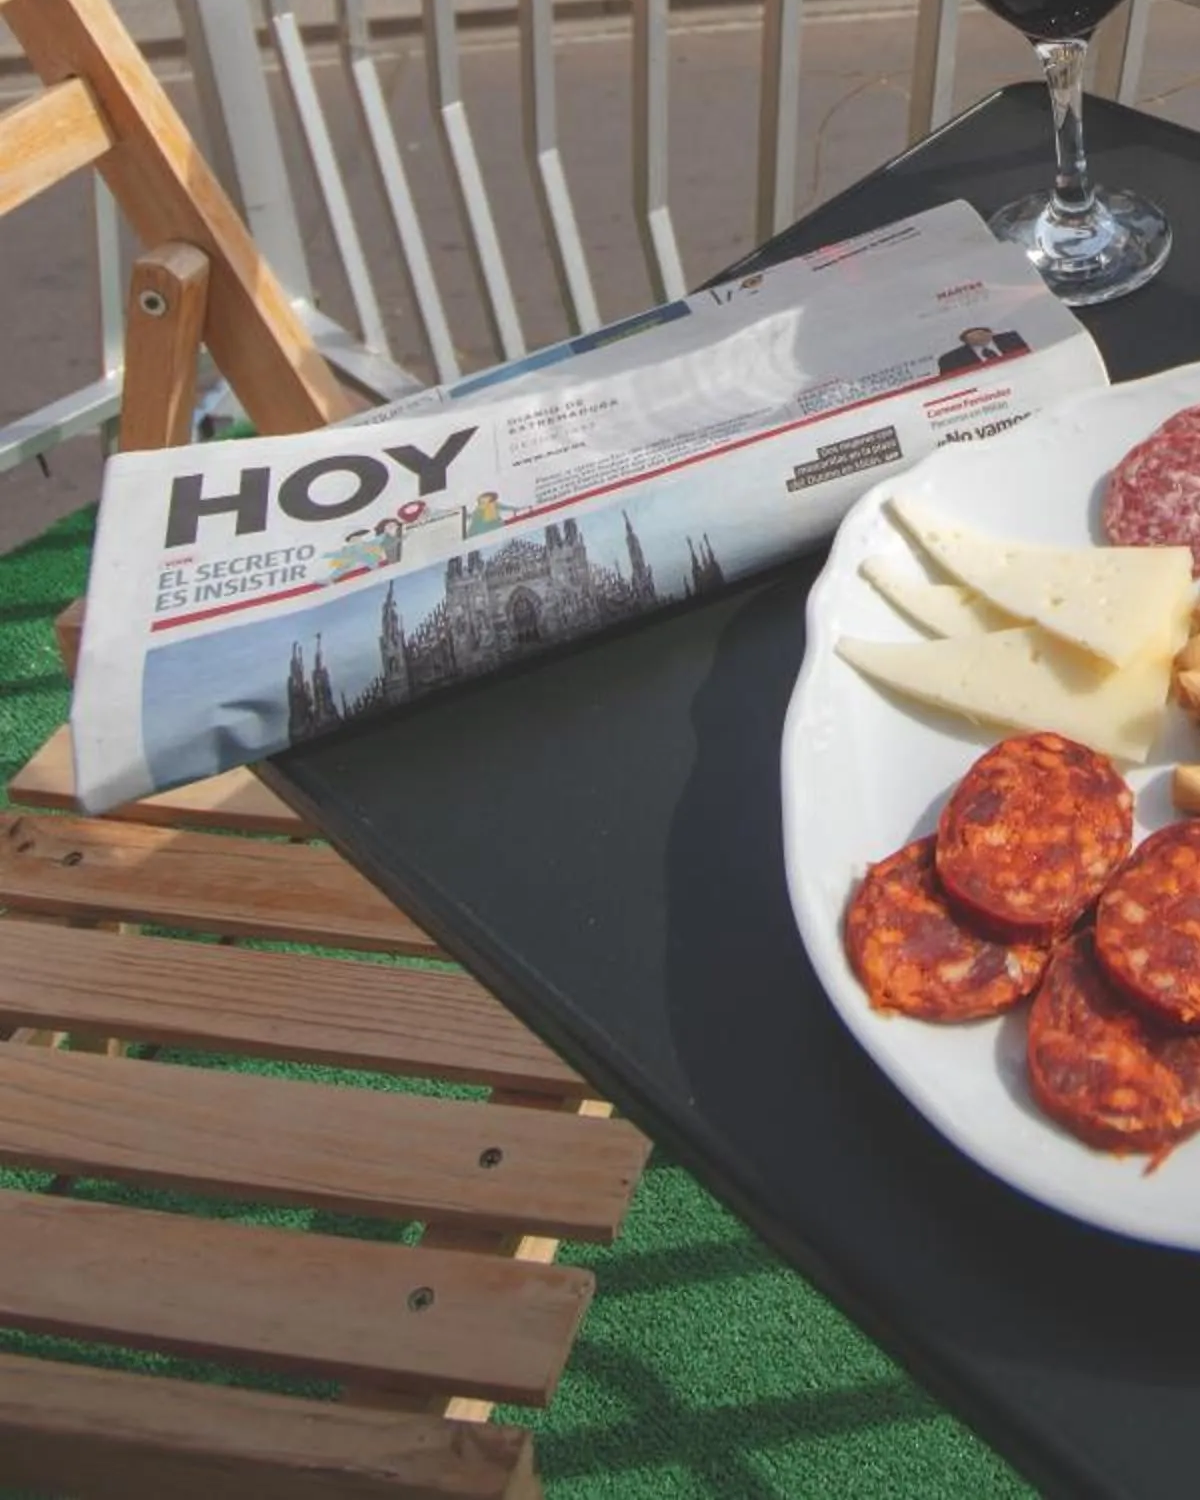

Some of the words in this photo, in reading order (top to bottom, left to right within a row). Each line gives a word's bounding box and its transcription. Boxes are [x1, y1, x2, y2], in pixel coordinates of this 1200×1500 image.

[164, 425, 480, 549] HOY
[155, 589, 188, 612] ES
[194, 565, 307, 603] INSISTIR
[158, 568, 190, 591] EL
[193, 544, 316, 583] SECRETO
